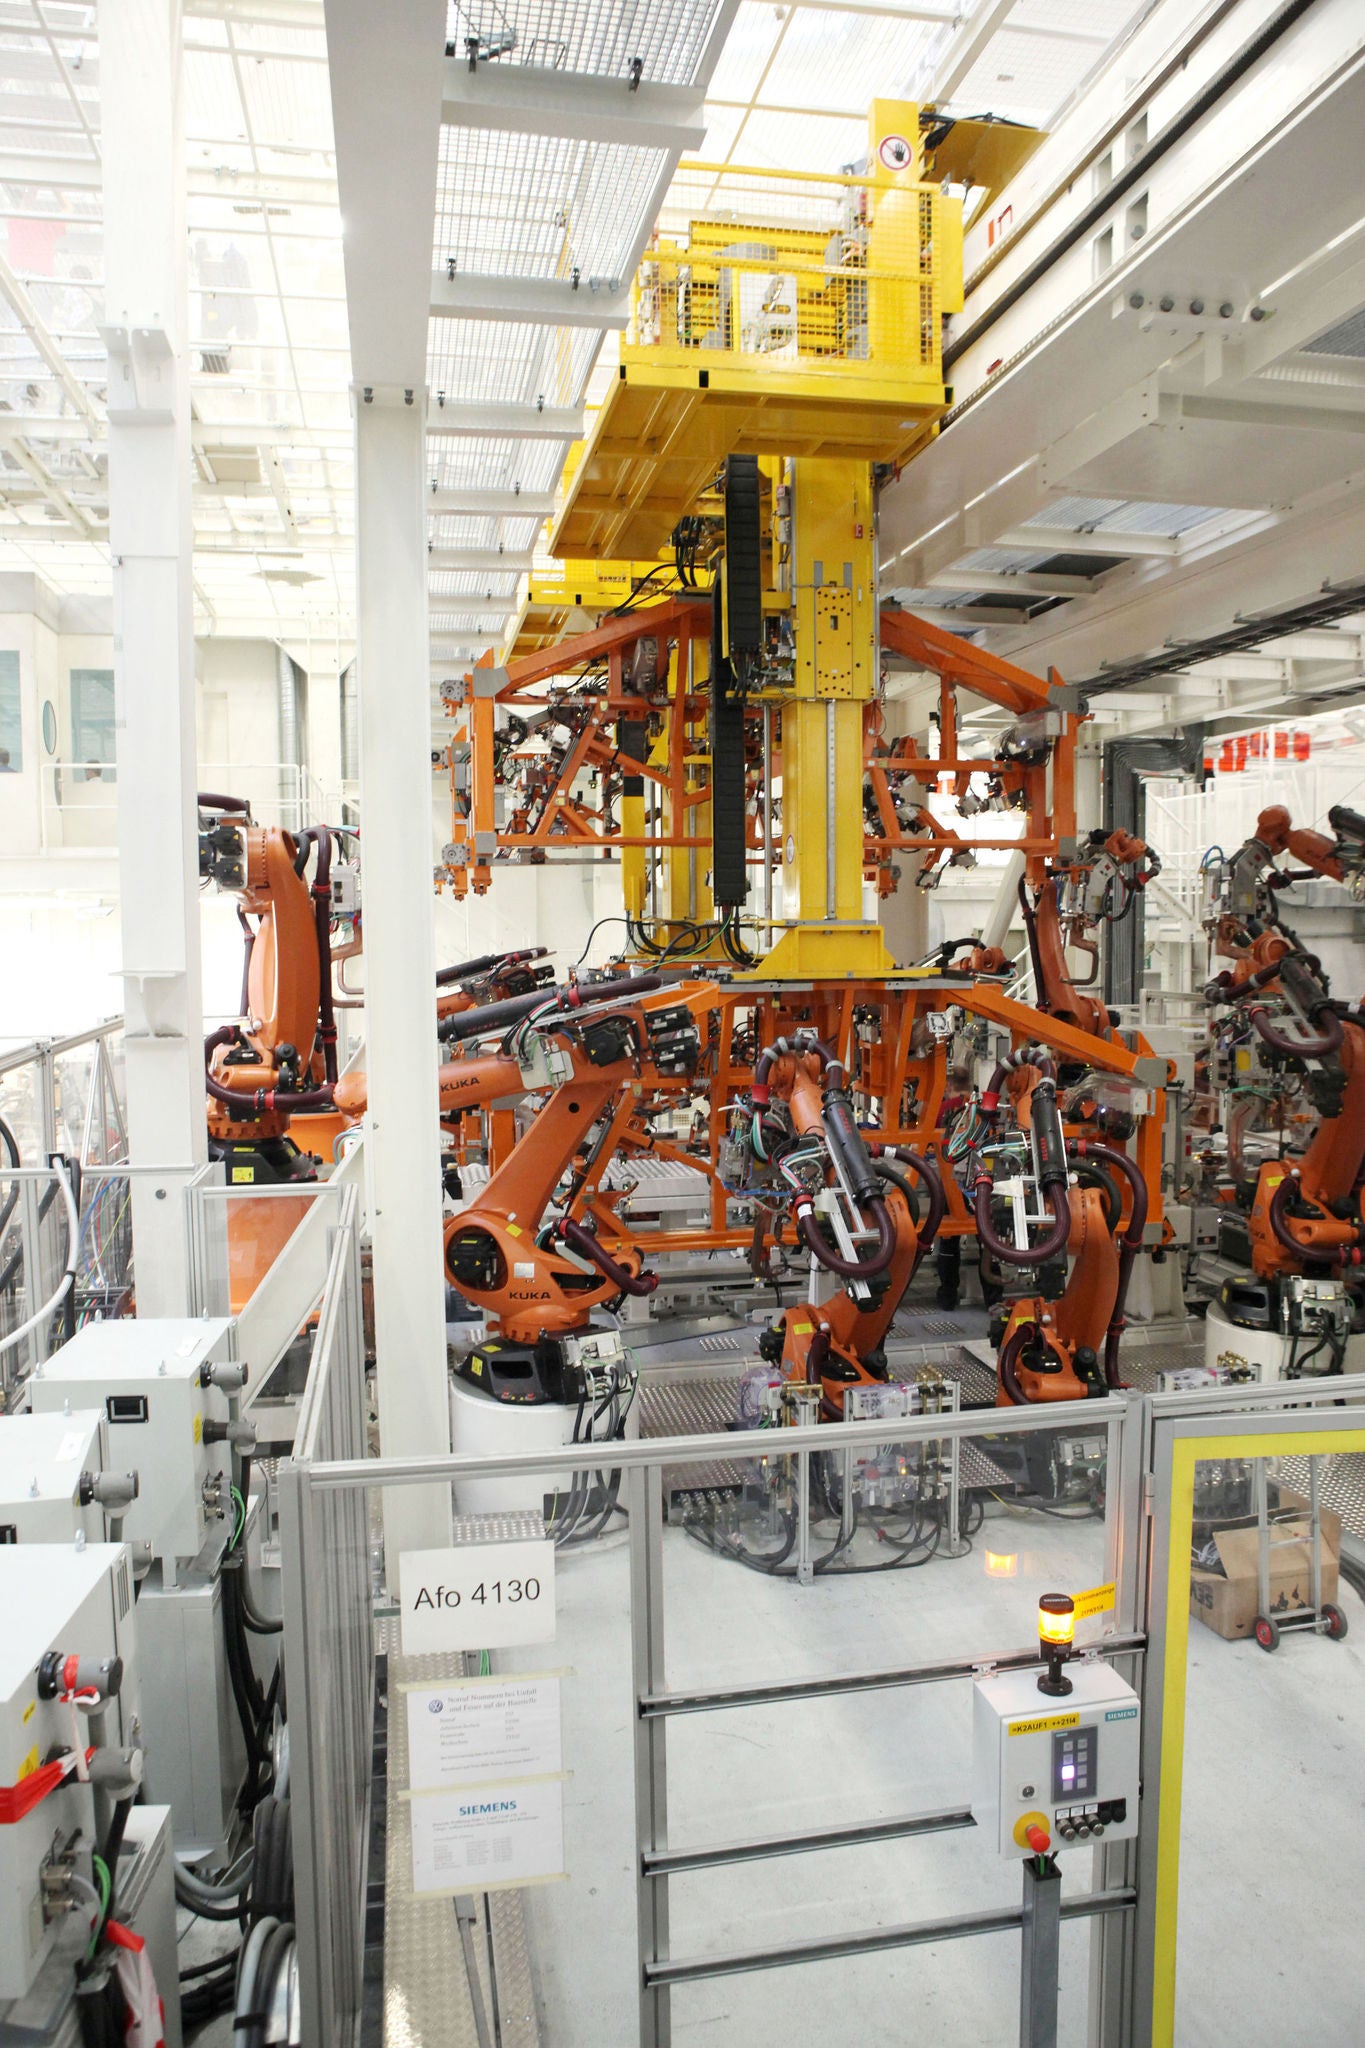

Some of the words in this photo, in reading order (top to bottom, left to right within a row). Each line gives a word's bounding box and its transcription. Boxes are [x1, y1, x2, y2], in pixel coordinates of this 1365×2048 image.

[440, 1077, 480, 1092] KUKA
[509, 1291, 551, 1300] KUKA
[414, 1586, 461, 1610] Afo
[471, 1578, 541, 1605] 4130
[1107, 1710, 1136, 1720] SIEMENS
[459, 1800, 517, 1816] SIEMENS
